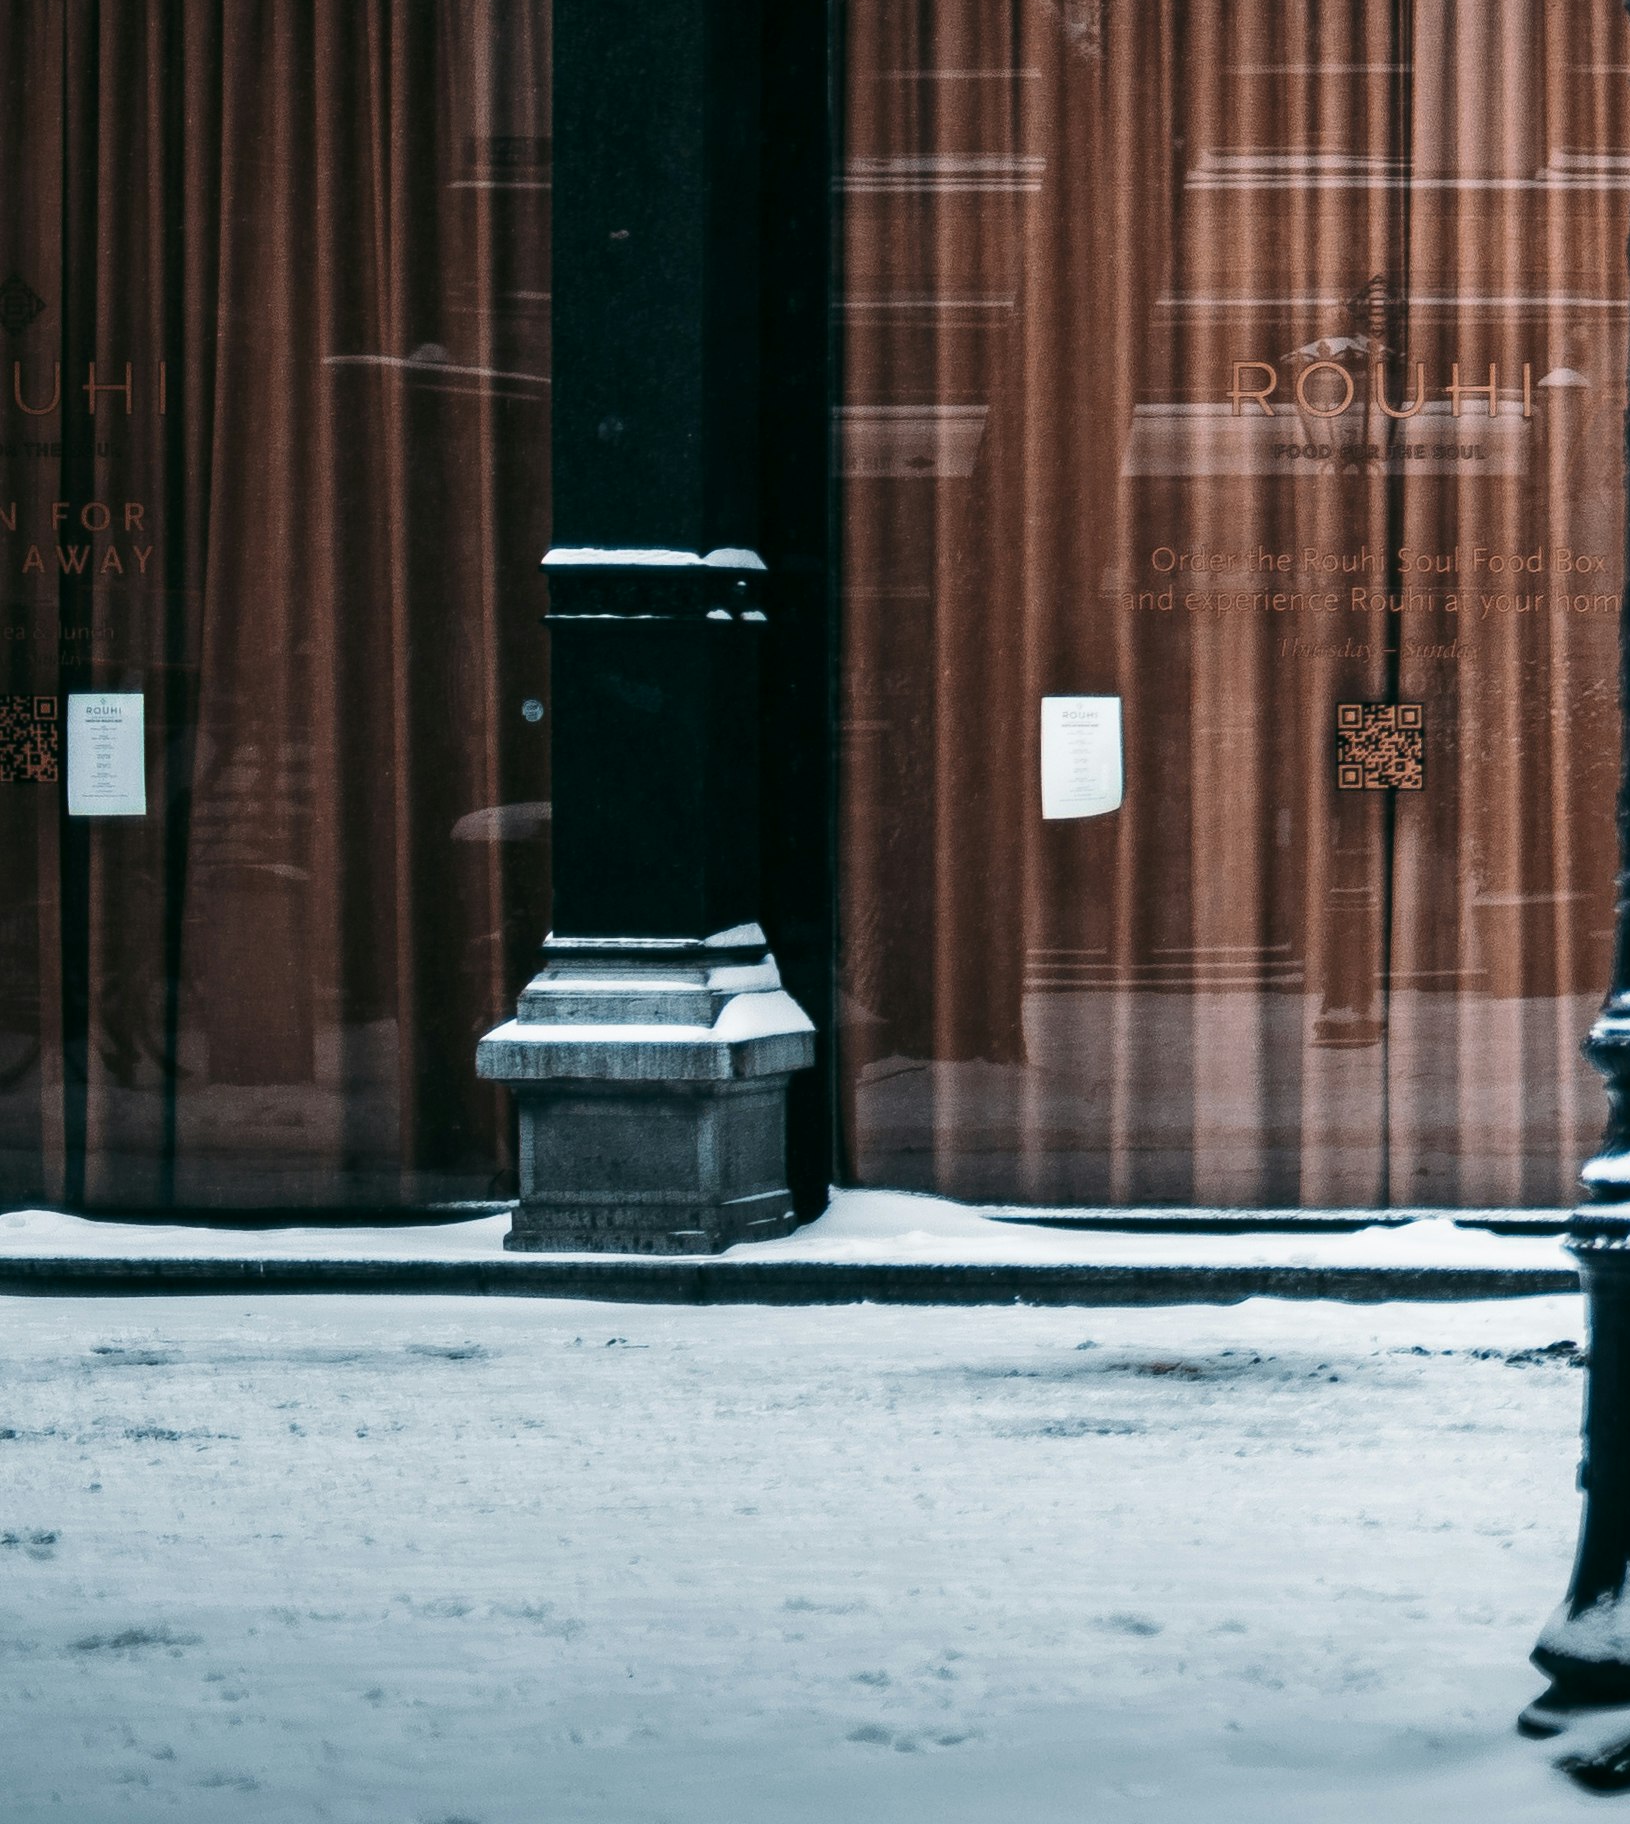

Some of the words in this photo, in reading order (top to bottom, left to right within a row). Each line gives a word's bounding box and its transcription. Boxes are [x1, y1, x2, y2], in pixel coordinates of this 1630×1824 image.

[1226, 361, 1532, 418] ROUHI
[1273, 443, 1332, 460] FOOD
[1387, 443, 1425, 460] THE
[1432, 443, 1488, 460] SOUL
[52, 501, 145, 532] FOR
[22, 544, 154, 575] AWAY
[1151, 546, 1232, 574] Order
[1246, 547, 1292, 574] the
[1303, 547, 1386, 574] Rouhi
[1397, 547, 1460, 574] Soul
[1472, 547, 1543, 574] Food
[1557, 547, 1606, 574] Box
[1121, 587, 1173, 614] and
[1185, 588, 1338, 625] experience
[1351, 587, 1433, 614] Rouhi
[1444, 590, 1471, 614] at
[1480, 593, 1544, 625] your
[86, 707, 122, 715] ROUHI
